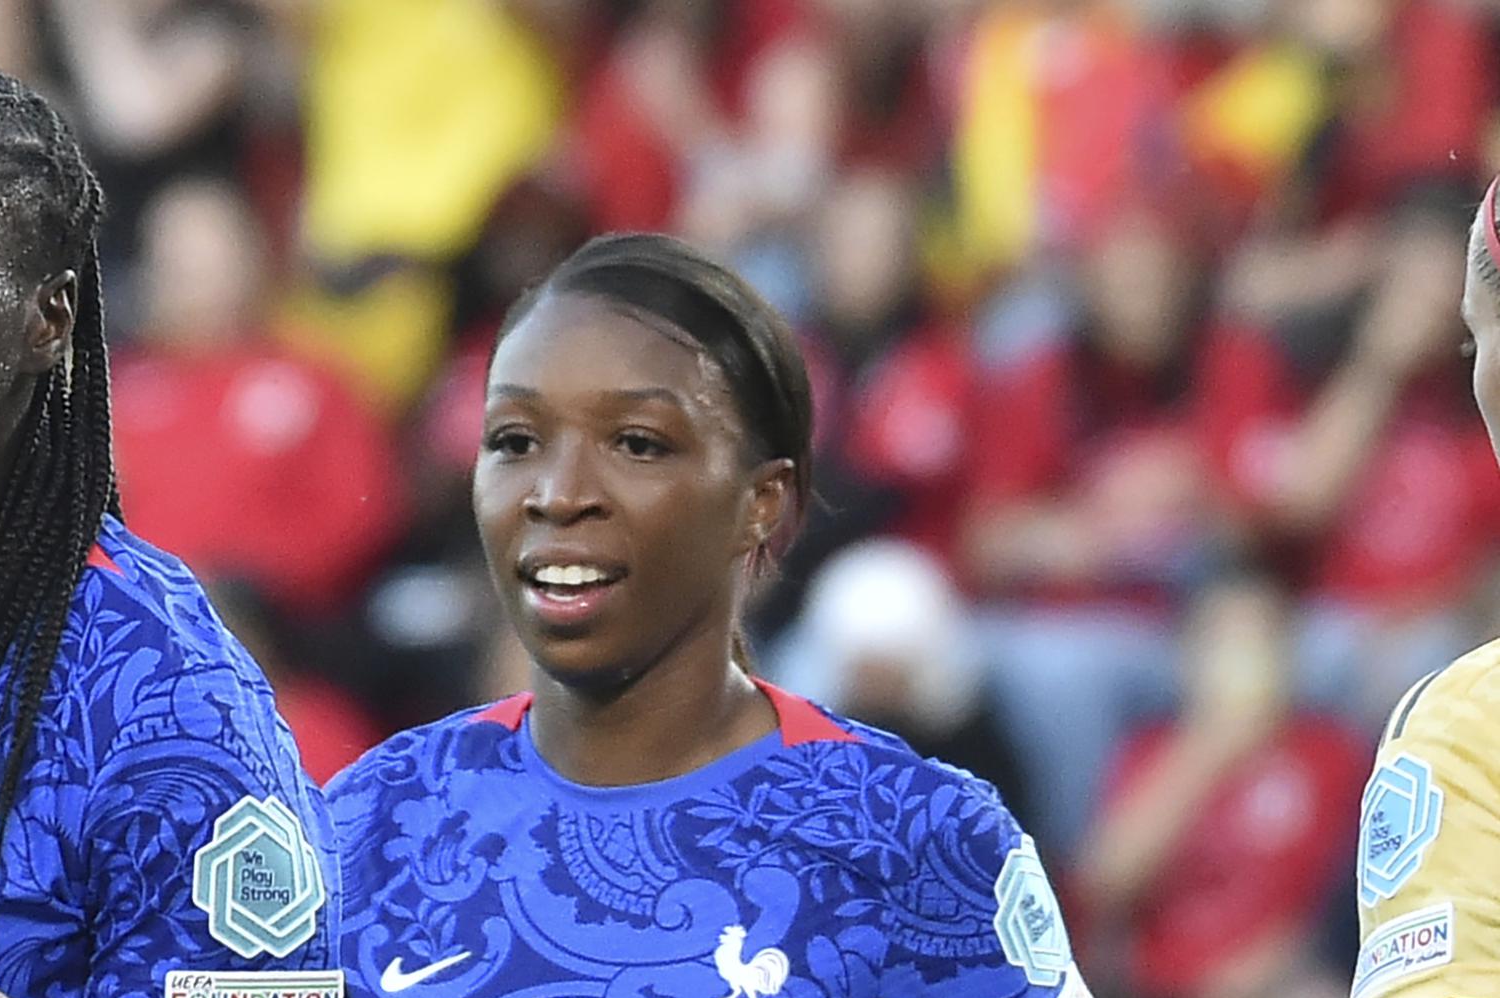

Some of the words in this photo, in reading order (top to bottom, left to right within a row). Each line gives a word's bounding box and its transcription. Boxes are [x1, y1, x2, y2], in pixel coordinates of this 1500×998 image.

[242, 851, 263, 865] We
[242, 868, 273, 886] Play
[241, 888, 290, 905] Strong
[171, 975, 212, 990] UEFA
